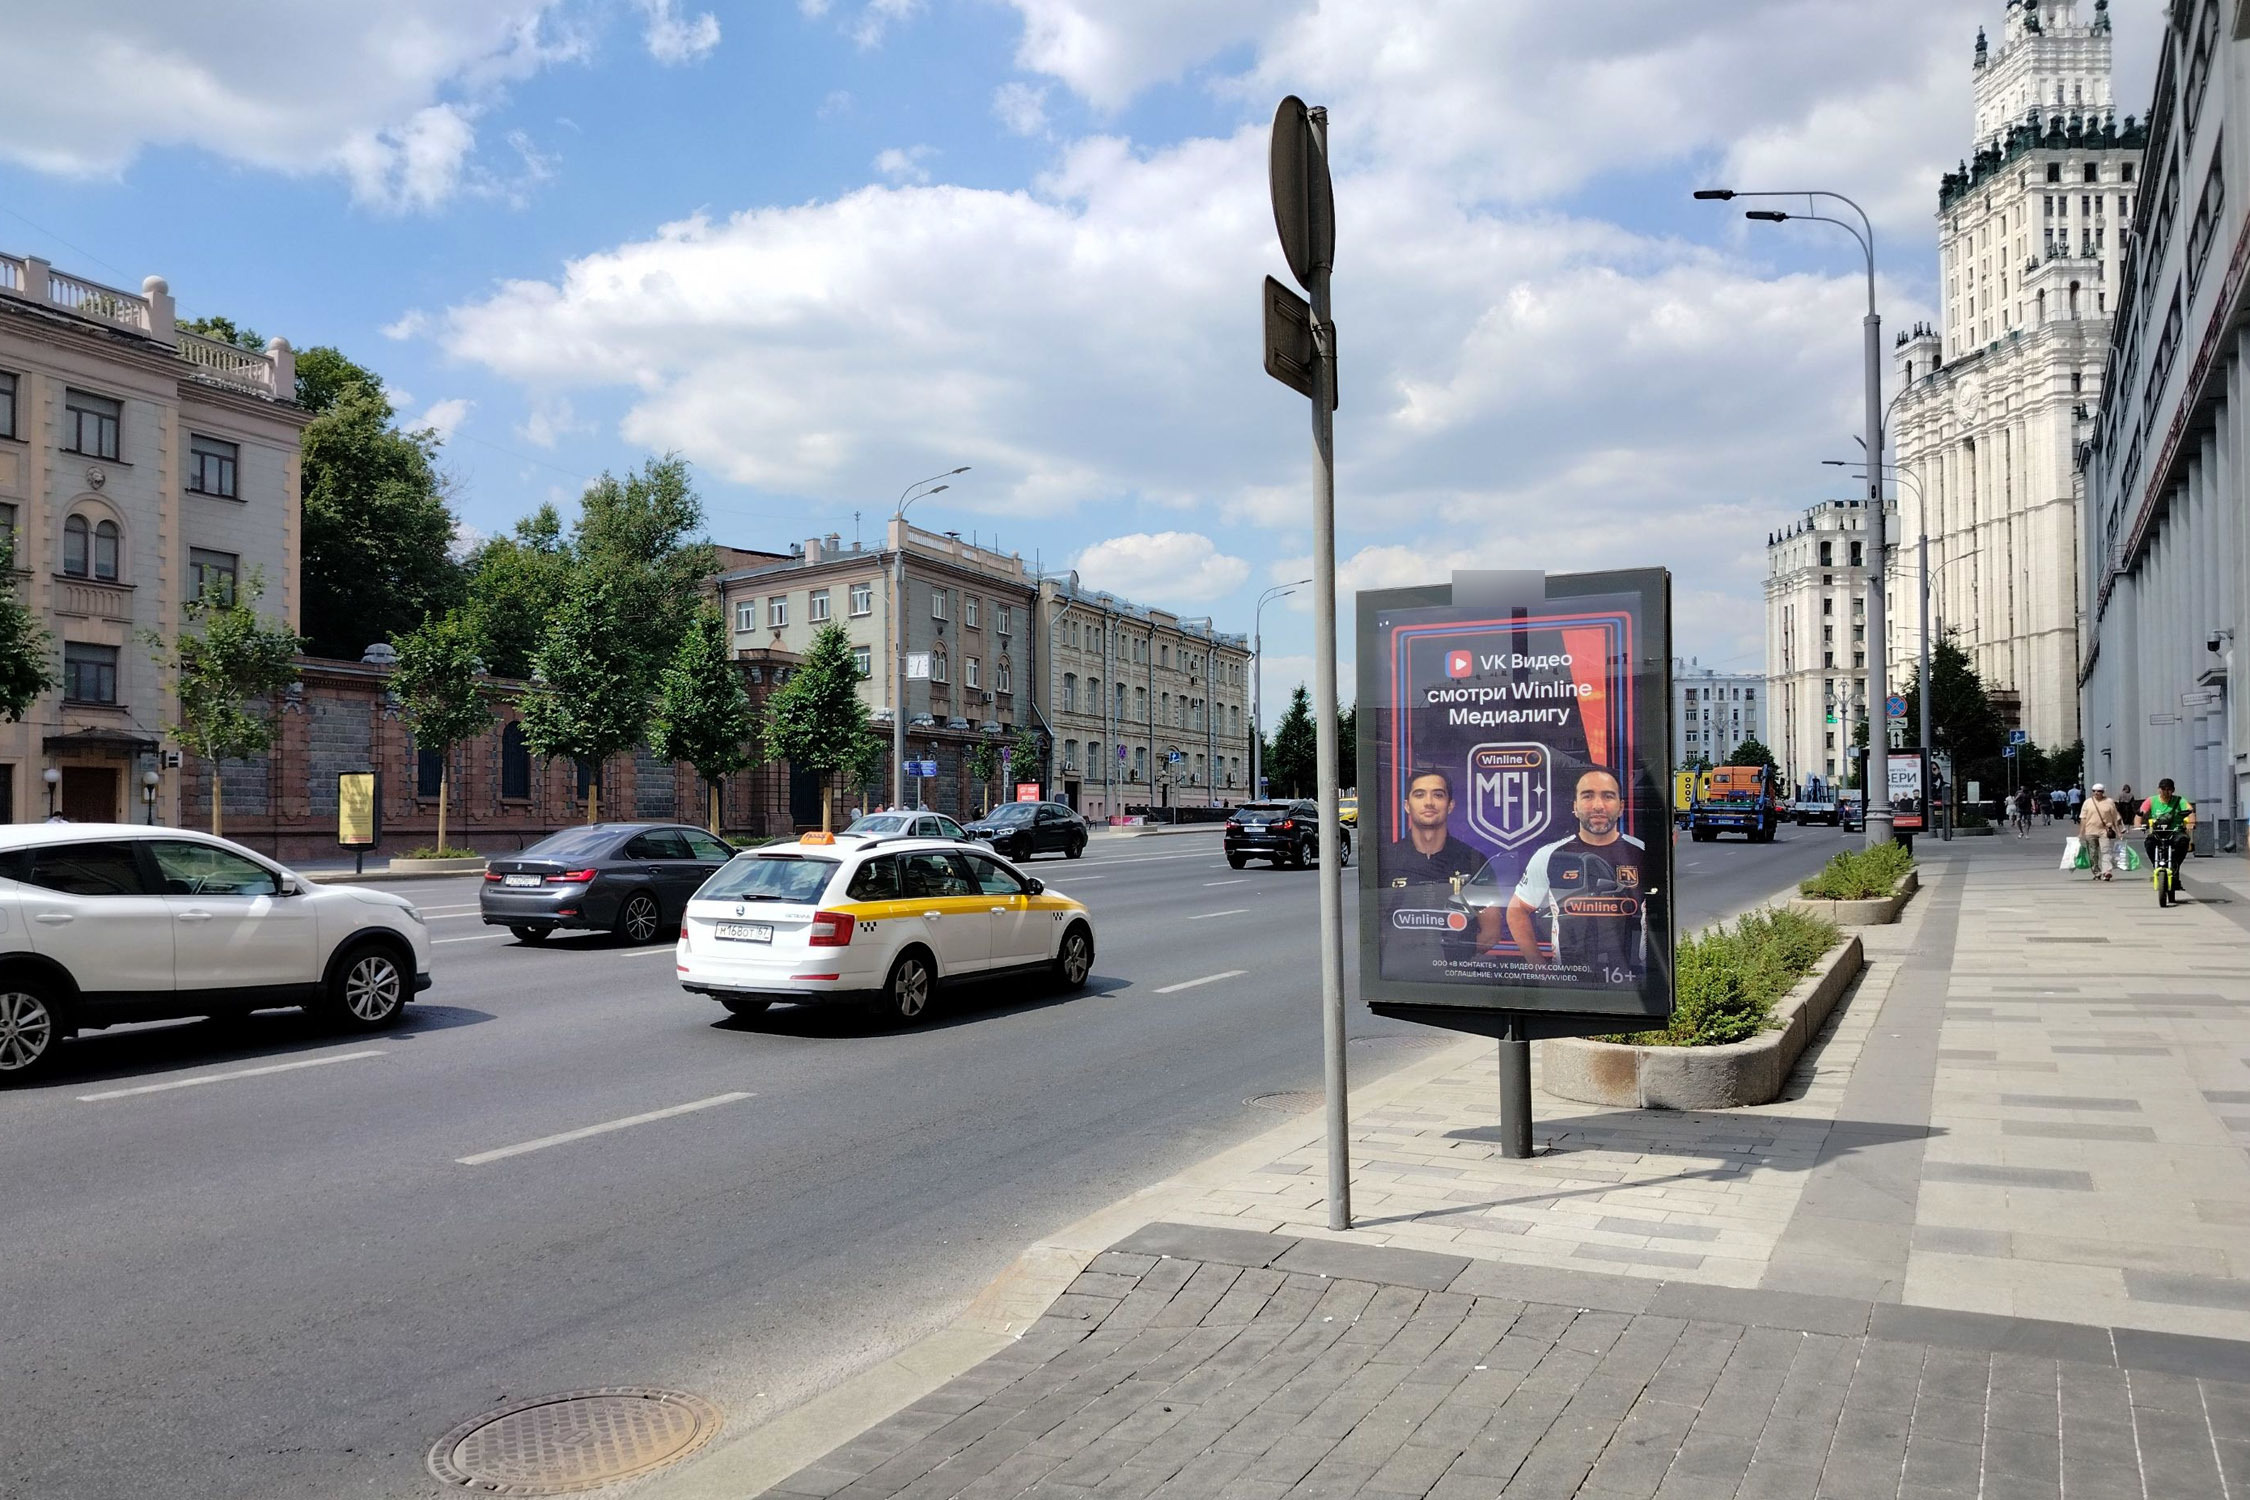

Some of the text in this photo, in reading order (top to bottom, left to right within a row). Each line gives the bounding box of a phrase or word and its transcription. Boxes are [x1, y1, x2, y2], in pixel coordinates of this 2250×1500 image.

[1480, 653, 1573, 670] VK Видео
[1427, 680, 1592, 705] смотри Winline
[1449, 705, 1570, 727] Медиалигу
[1481, 755, 1523, 765] Winline
[1570, 901, 1618, 912] Winline
[1398, 914, 1445, 926] Winline
[1445, 970, 1493, 978] СОГЛАШЕНИЕ:
[1602, 966, 1636, 983] 16+
